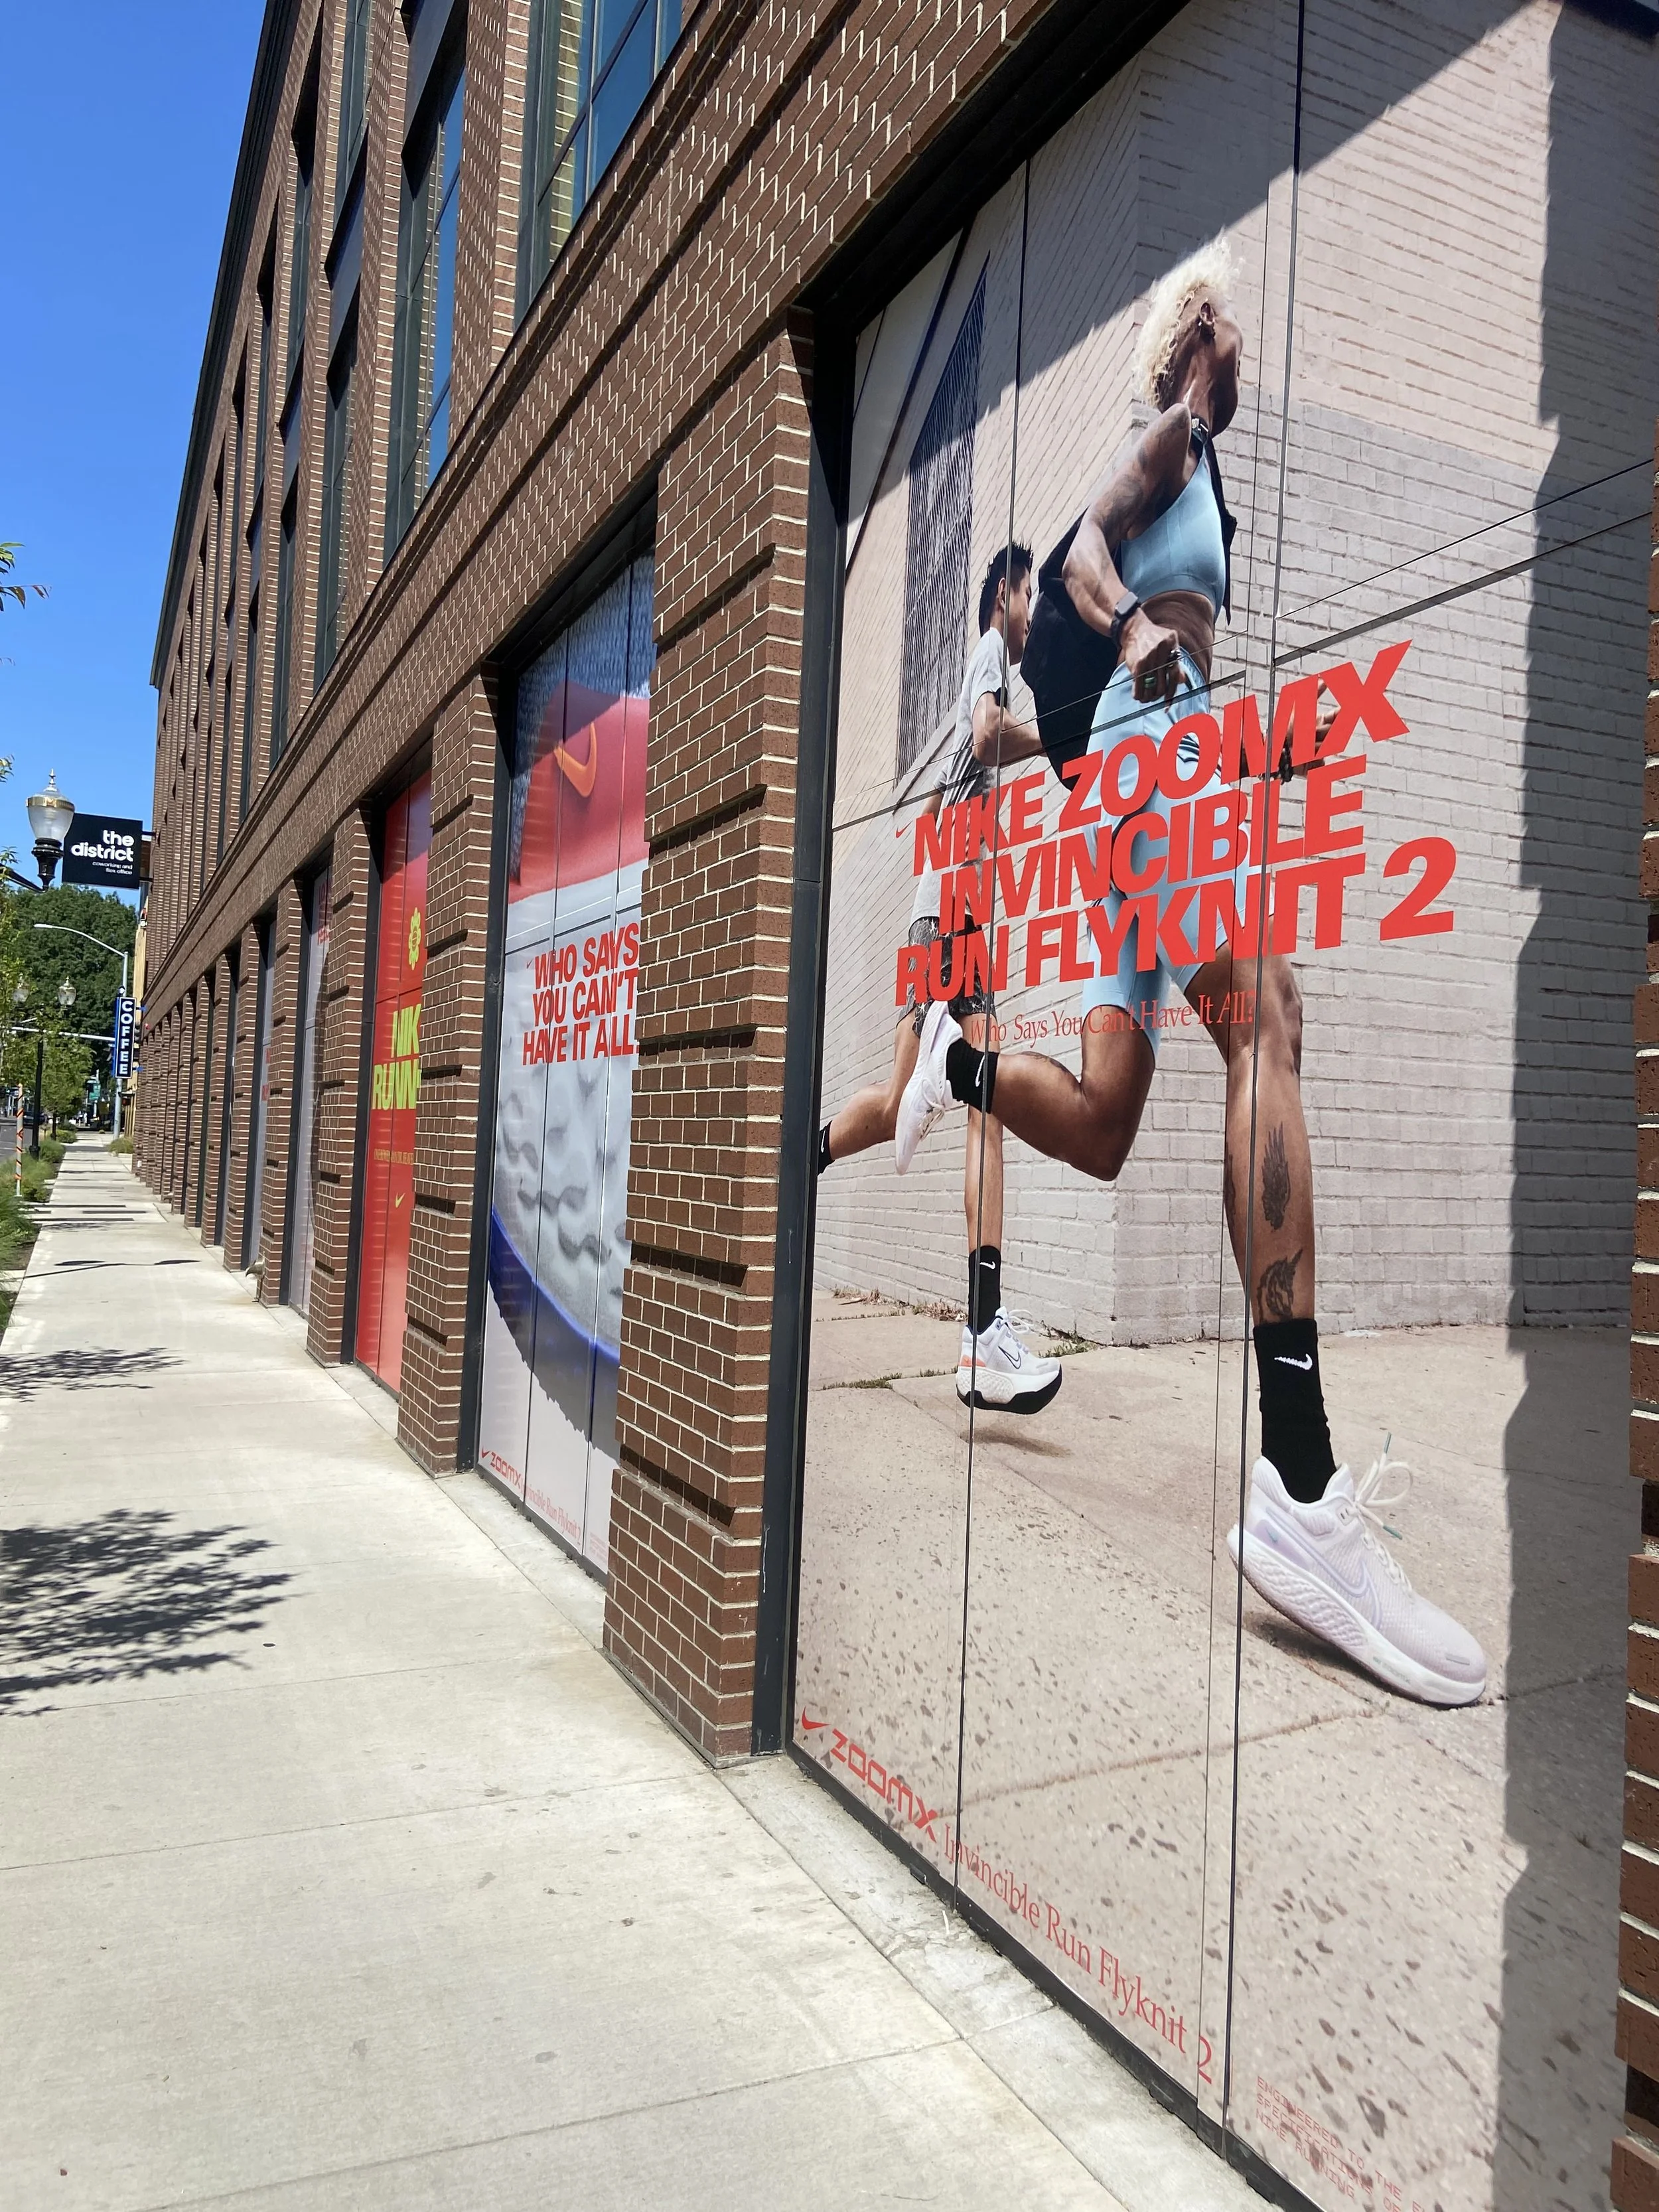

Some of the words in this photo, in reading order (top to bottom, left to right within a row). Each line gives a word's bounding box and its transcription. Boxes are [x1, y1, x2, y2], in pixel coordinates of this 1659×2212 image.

[914, 771, 1045, 877] NIKE
[1059, 639, 1412, 832] ZOOMX
[71, 842, 134, 862] district
[103, 830, 135, 847] the
[939, 754, 1366, 934] INVINCIBLE
[895, 925, 1009, 1006] RUN
[1025, 853, 1366, 987] FLYKNIT
[1380, 837, 1457, 941] 2
[535, 944, 577, 990] WHO
[583, 922, 639, 978] SAYS
[391, 1003, 421, 1058] NIK
[533, 986, 567, 1027] YOU
[573, 968, 638, 1021] CAN'T
[971, 1016, 1007, 1045] Who
[1013, 1014, 1048, 1048] Says
[1052, 1009, 1083, 1037] You
[1088, 1004, 1135, 1035] Can't
[1139, 999, 1192, 1031] Have
[1197, 994, 1214, 1025] It
[119, 1000, 133, 1074] COFFEE
[522, 1025, 567, 1065] HAVE
[572, 1021, 590, 1061] IT
[944, 1822, 1040, 1929] Invincible
[1045, 1904, 1092, 1975] Run
[1098, 1945, 1187, 2053] Flyknit
[1196, 2035, 1213, 2085] 2
[1257, 2075, 1339, 2149] ENGINEERED
[1348, 2148, 1365, 2170] TO
[1374, 2169, 1402, 2201] THE
